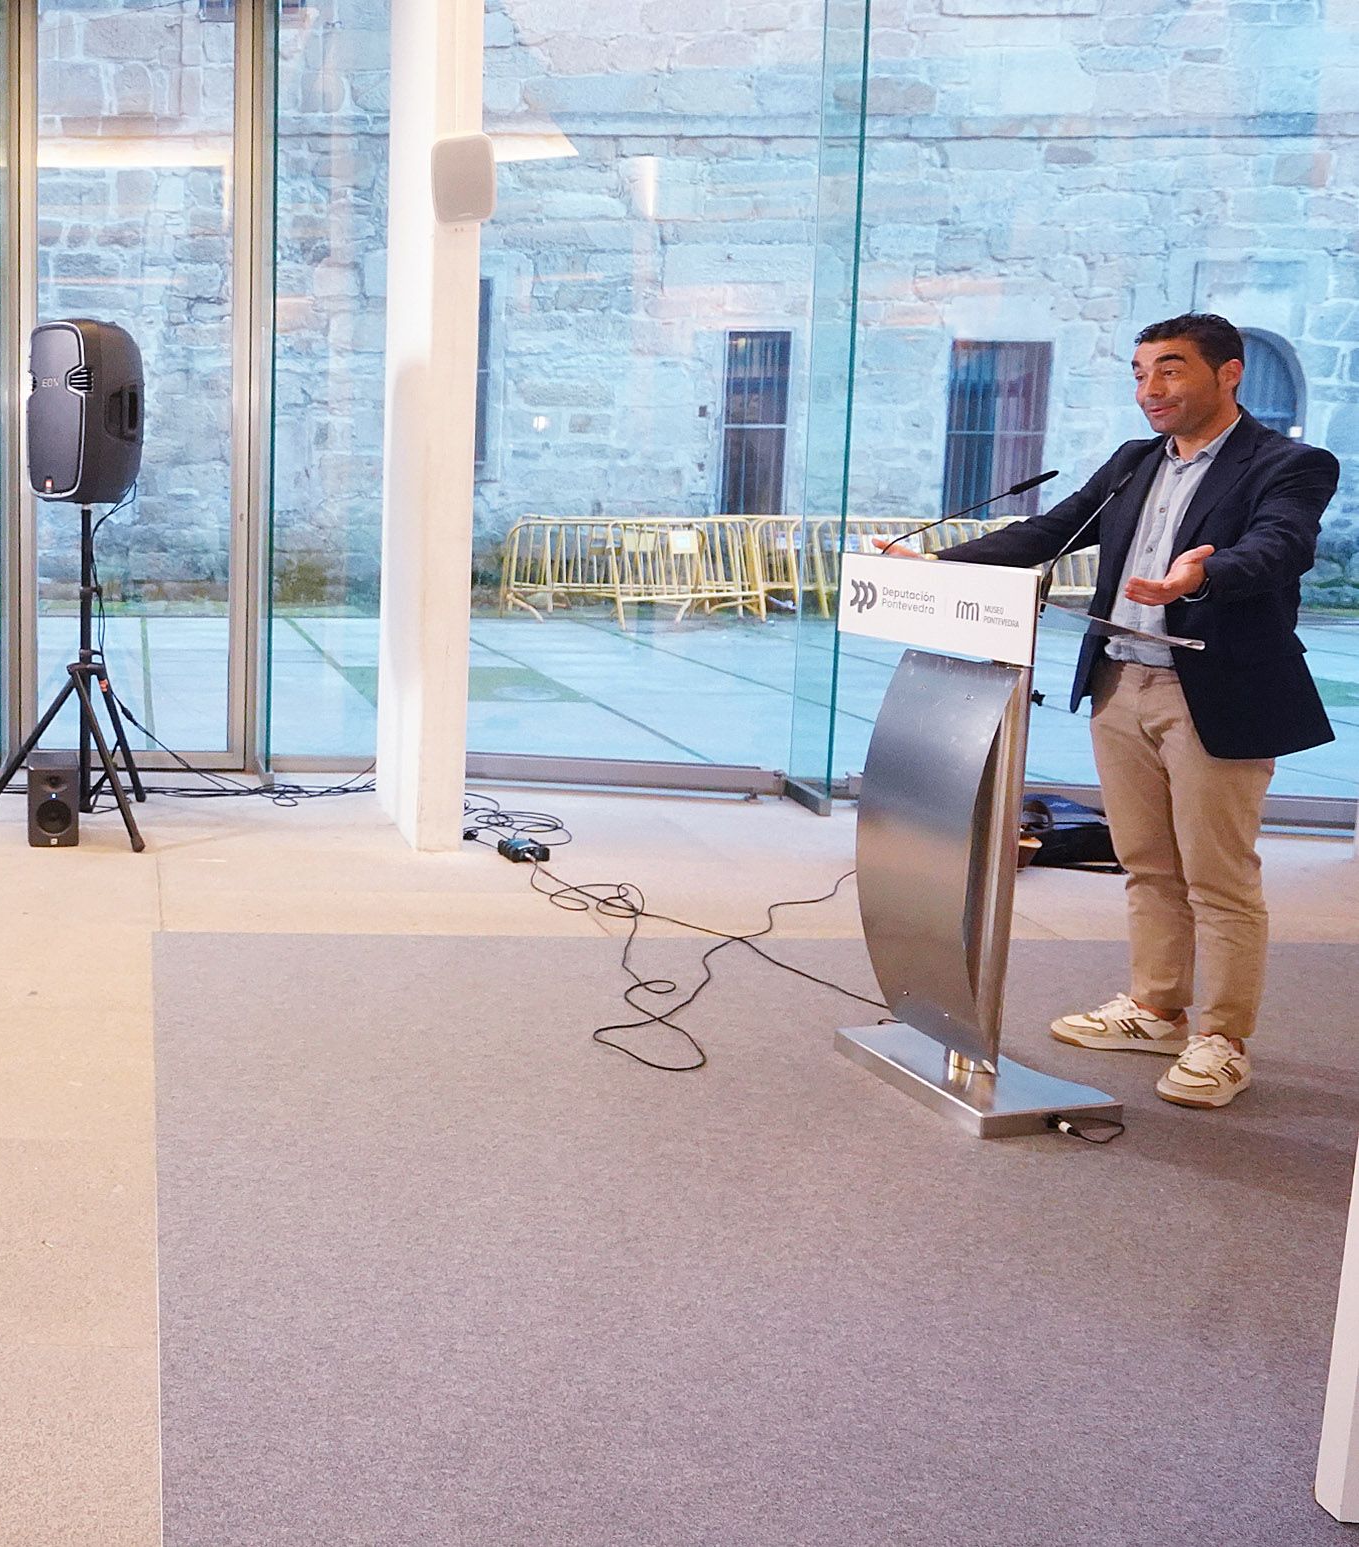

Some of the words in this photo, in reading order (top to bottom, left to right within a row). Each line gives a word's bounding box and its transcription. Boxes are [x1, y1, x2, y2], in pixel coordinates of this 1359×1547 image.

[882, 586, 935, 603] Deputación
[882, 598, 935, 615] Pontevedra
[984, 605, 1004, 615] MUSEO
[983, 615, 1020, 628] PONTEVEDRA
